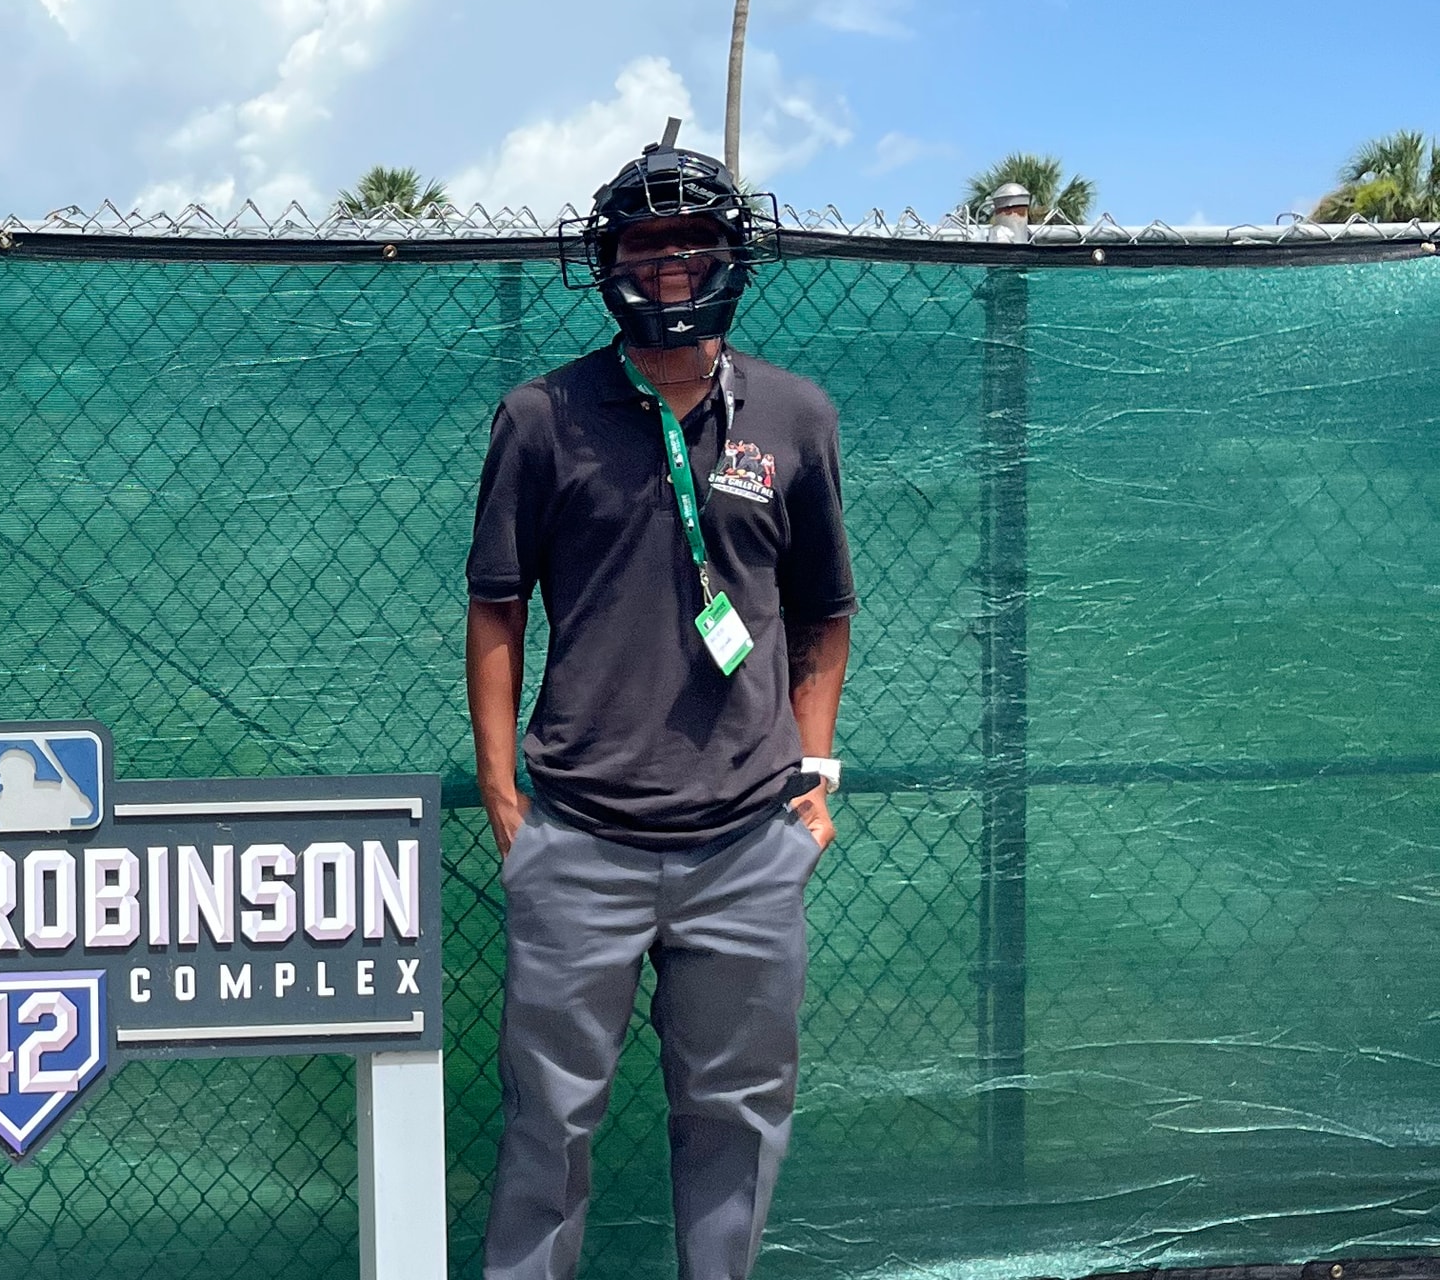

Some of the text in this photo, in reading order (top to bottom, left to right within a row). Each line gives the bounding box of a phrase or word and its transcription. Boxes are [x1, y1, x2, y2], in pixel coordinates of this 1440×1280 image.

[728, 477, 753, 490] CALLS
[760, 487, 774, 499] ALL
[129, 958, 421, 1005] COMPLEX
